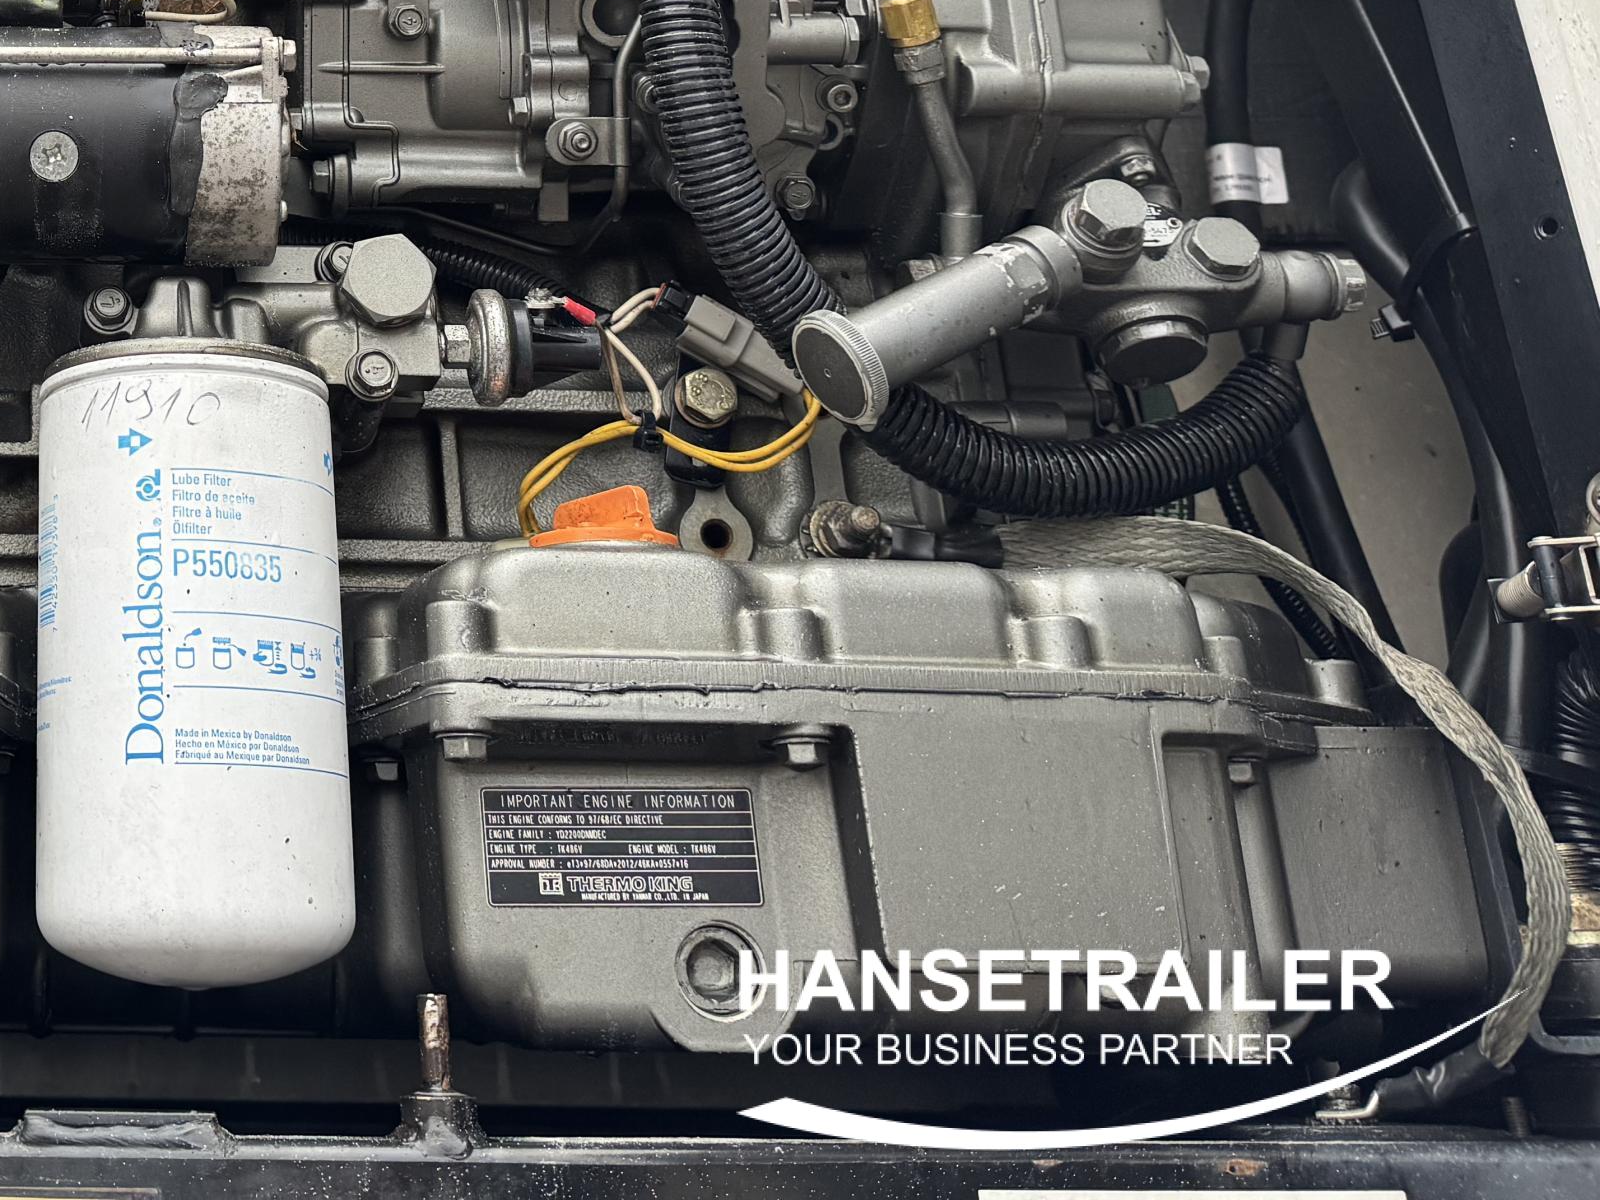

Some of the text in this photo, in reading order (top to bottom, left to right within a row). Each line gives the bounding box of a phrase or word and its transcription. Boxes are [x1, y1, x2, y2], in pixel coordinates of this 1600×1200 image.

[172, 473, 232, 487] Lube Filter
[172, 489, 201, 501] Filtro
[205, 490, 219, 502] de
[172, 506, 242, 520] Filtre à huile
[173, 520, 212, 535] Ölfilter
[173, 548, 282, 583] P550835
[122, 531, 164, 765] Donaldson
[175, 729, 292, 742] Made in Mexico by Donaldson
[175, 739, 202, 748] Hecho
[217, 740, 247, 749] México
[263, 742, 300, 753] Donaldson
[226, 751, 260, 761] Mexique
[262, 754, 274, 762] par
[276, 753, 310, 765] Donaldson
[500, 794, 735, 808] IMPORTANT ENGINE INFORMATION
[488, 814, 505, 825] THIS
[508, 814, 534, 825] ENGINE
[537, 814, 572, 825] CONFORMS
[575, 814, 585, 825] TO
[625, 814, 664, 825] DIRECTIVE
[488, 829, 514, 840] ENGINE
[518, 829, 544, 840] FAMILY
[489, 844, 516, 854] ENGINE
[520, 844, 537, 854] TYPE
[628, 844, 654, 854] ENGINE
[657, 844, 679, 854] MODEL
[491, 859, 525, 869] APPROVAL
[529, 859, 555, 869] NUMBER
[566, 875, 647, 892] THERMO
[649, 875, 694, 893] KING
